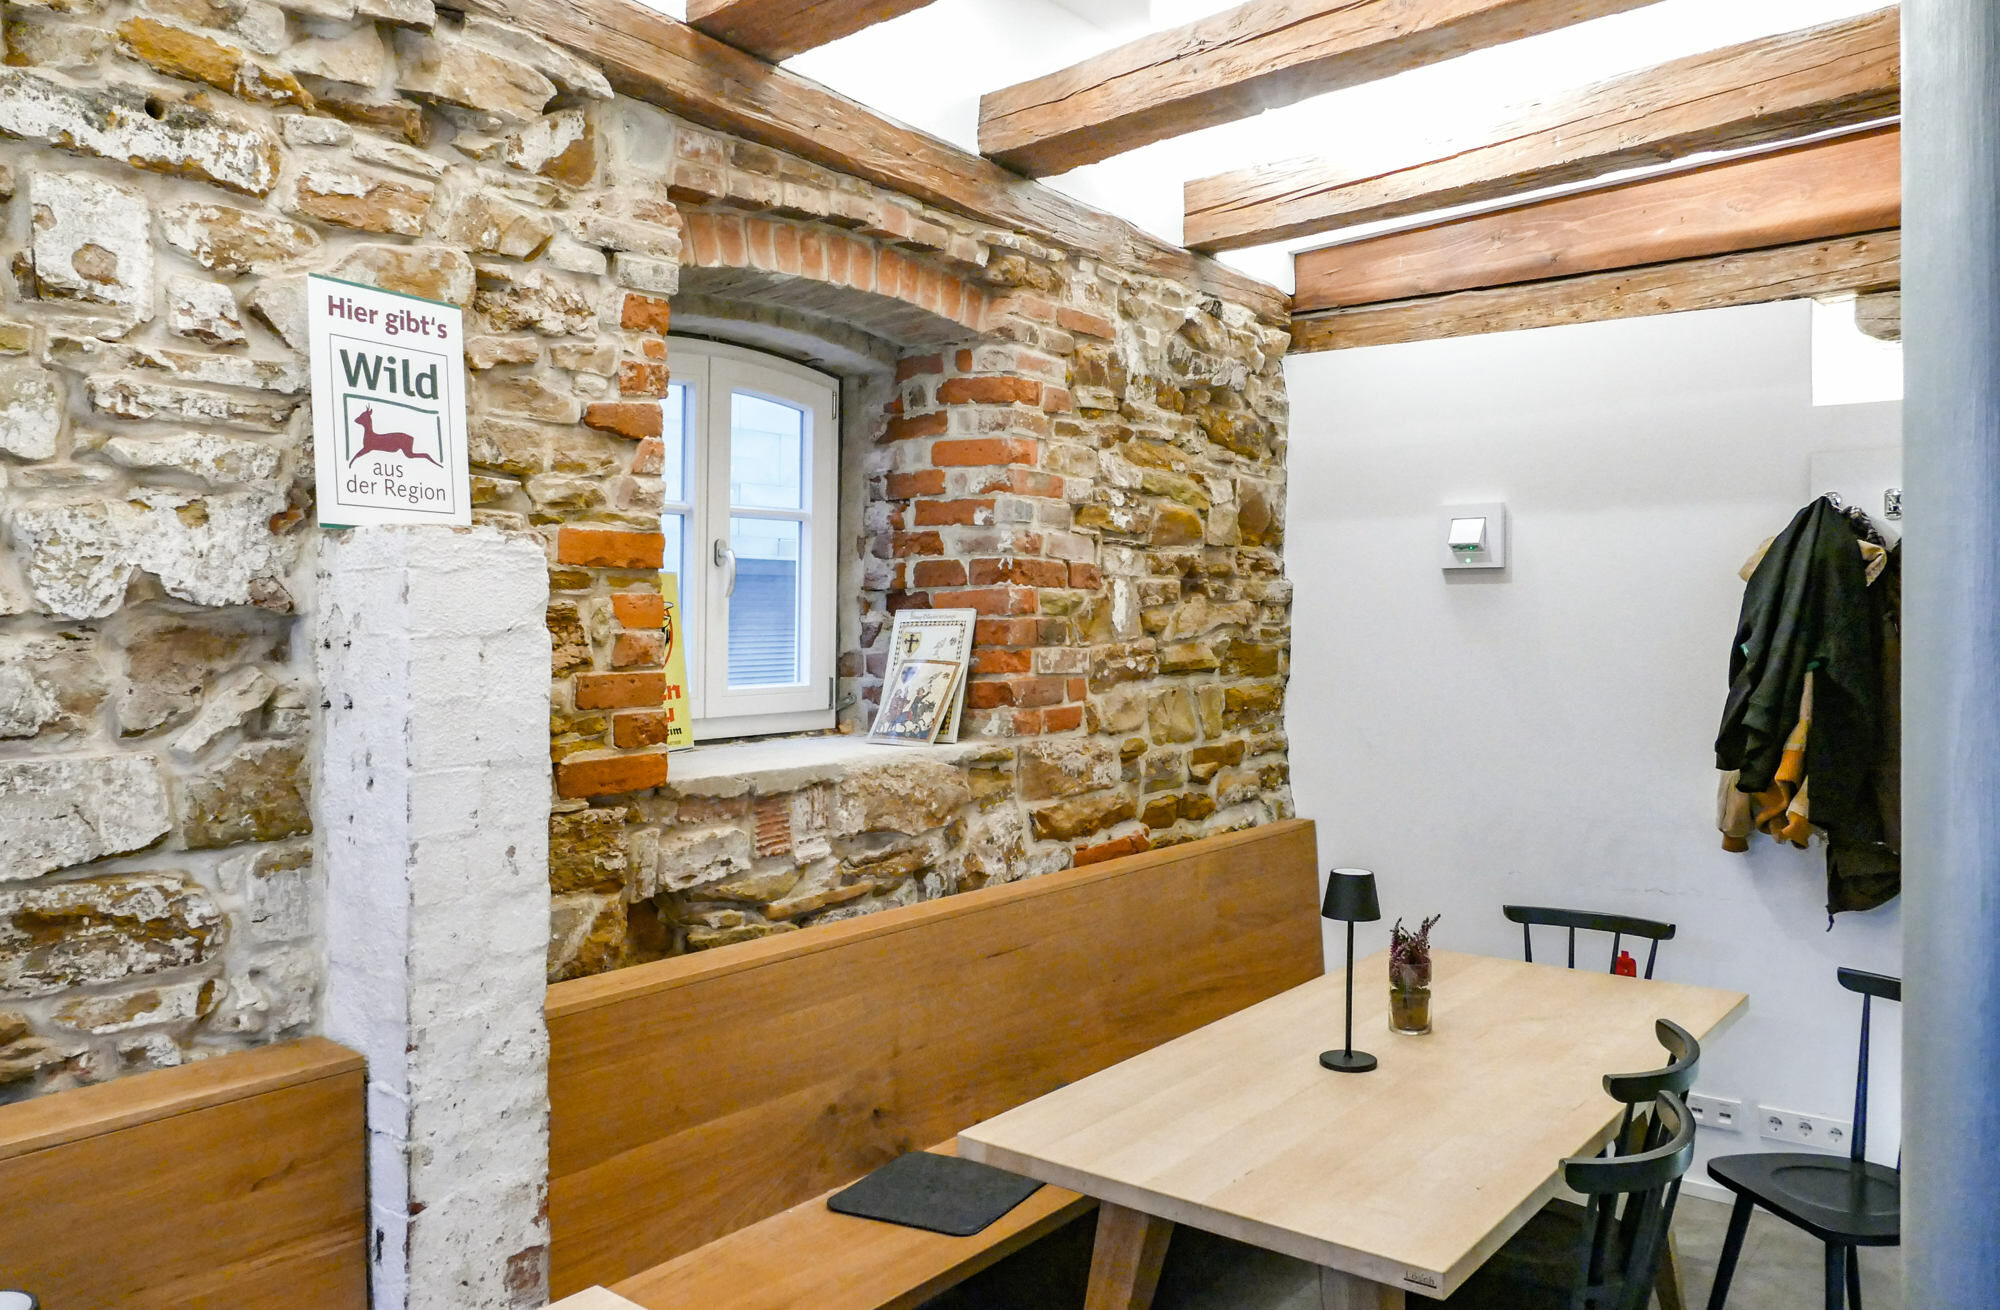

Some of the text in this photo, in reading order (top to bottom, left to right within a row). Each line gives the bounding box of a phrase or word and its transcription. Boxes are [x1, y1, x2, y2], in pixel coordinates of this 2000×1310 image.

[328, 295, 378, 324] Hier
[339, 349, 439, 400] Wild
[373, 462, 404, 478] aus
[346, 474, 446, 504] der Region
